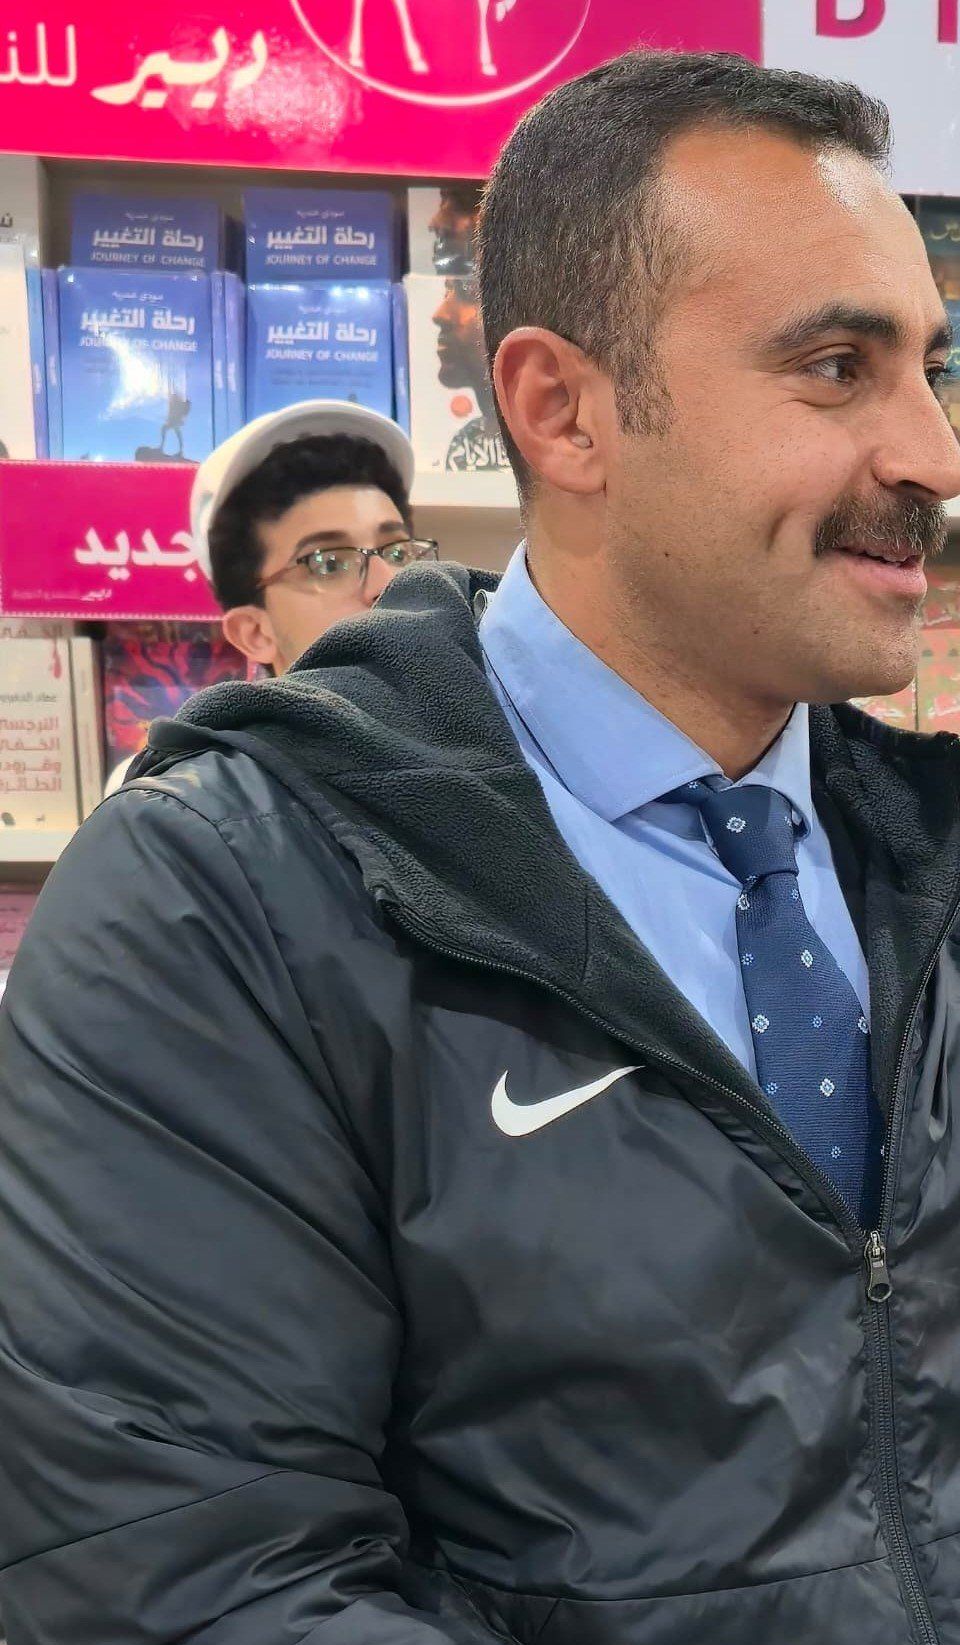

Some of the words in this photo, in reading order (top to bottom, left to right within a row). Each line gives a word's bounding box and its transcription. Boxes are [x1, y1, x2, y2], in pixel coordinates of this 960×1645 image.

[0, 23, 77, 87] للن
[92, 226, 156, 249] التغيير
[162, 228, 204, 252] رحلة
[266, 225, 327, 250] التغيير
[333, 225, 375, 249] رحلة
[80, 307, 146, 337] التغيير
[151, 309, 196, 335] رحلة
[266, 321, 329, 345] التغيير
[335, 322, 377, 346] رحلة
[74, 527, 198, 582] جديد
